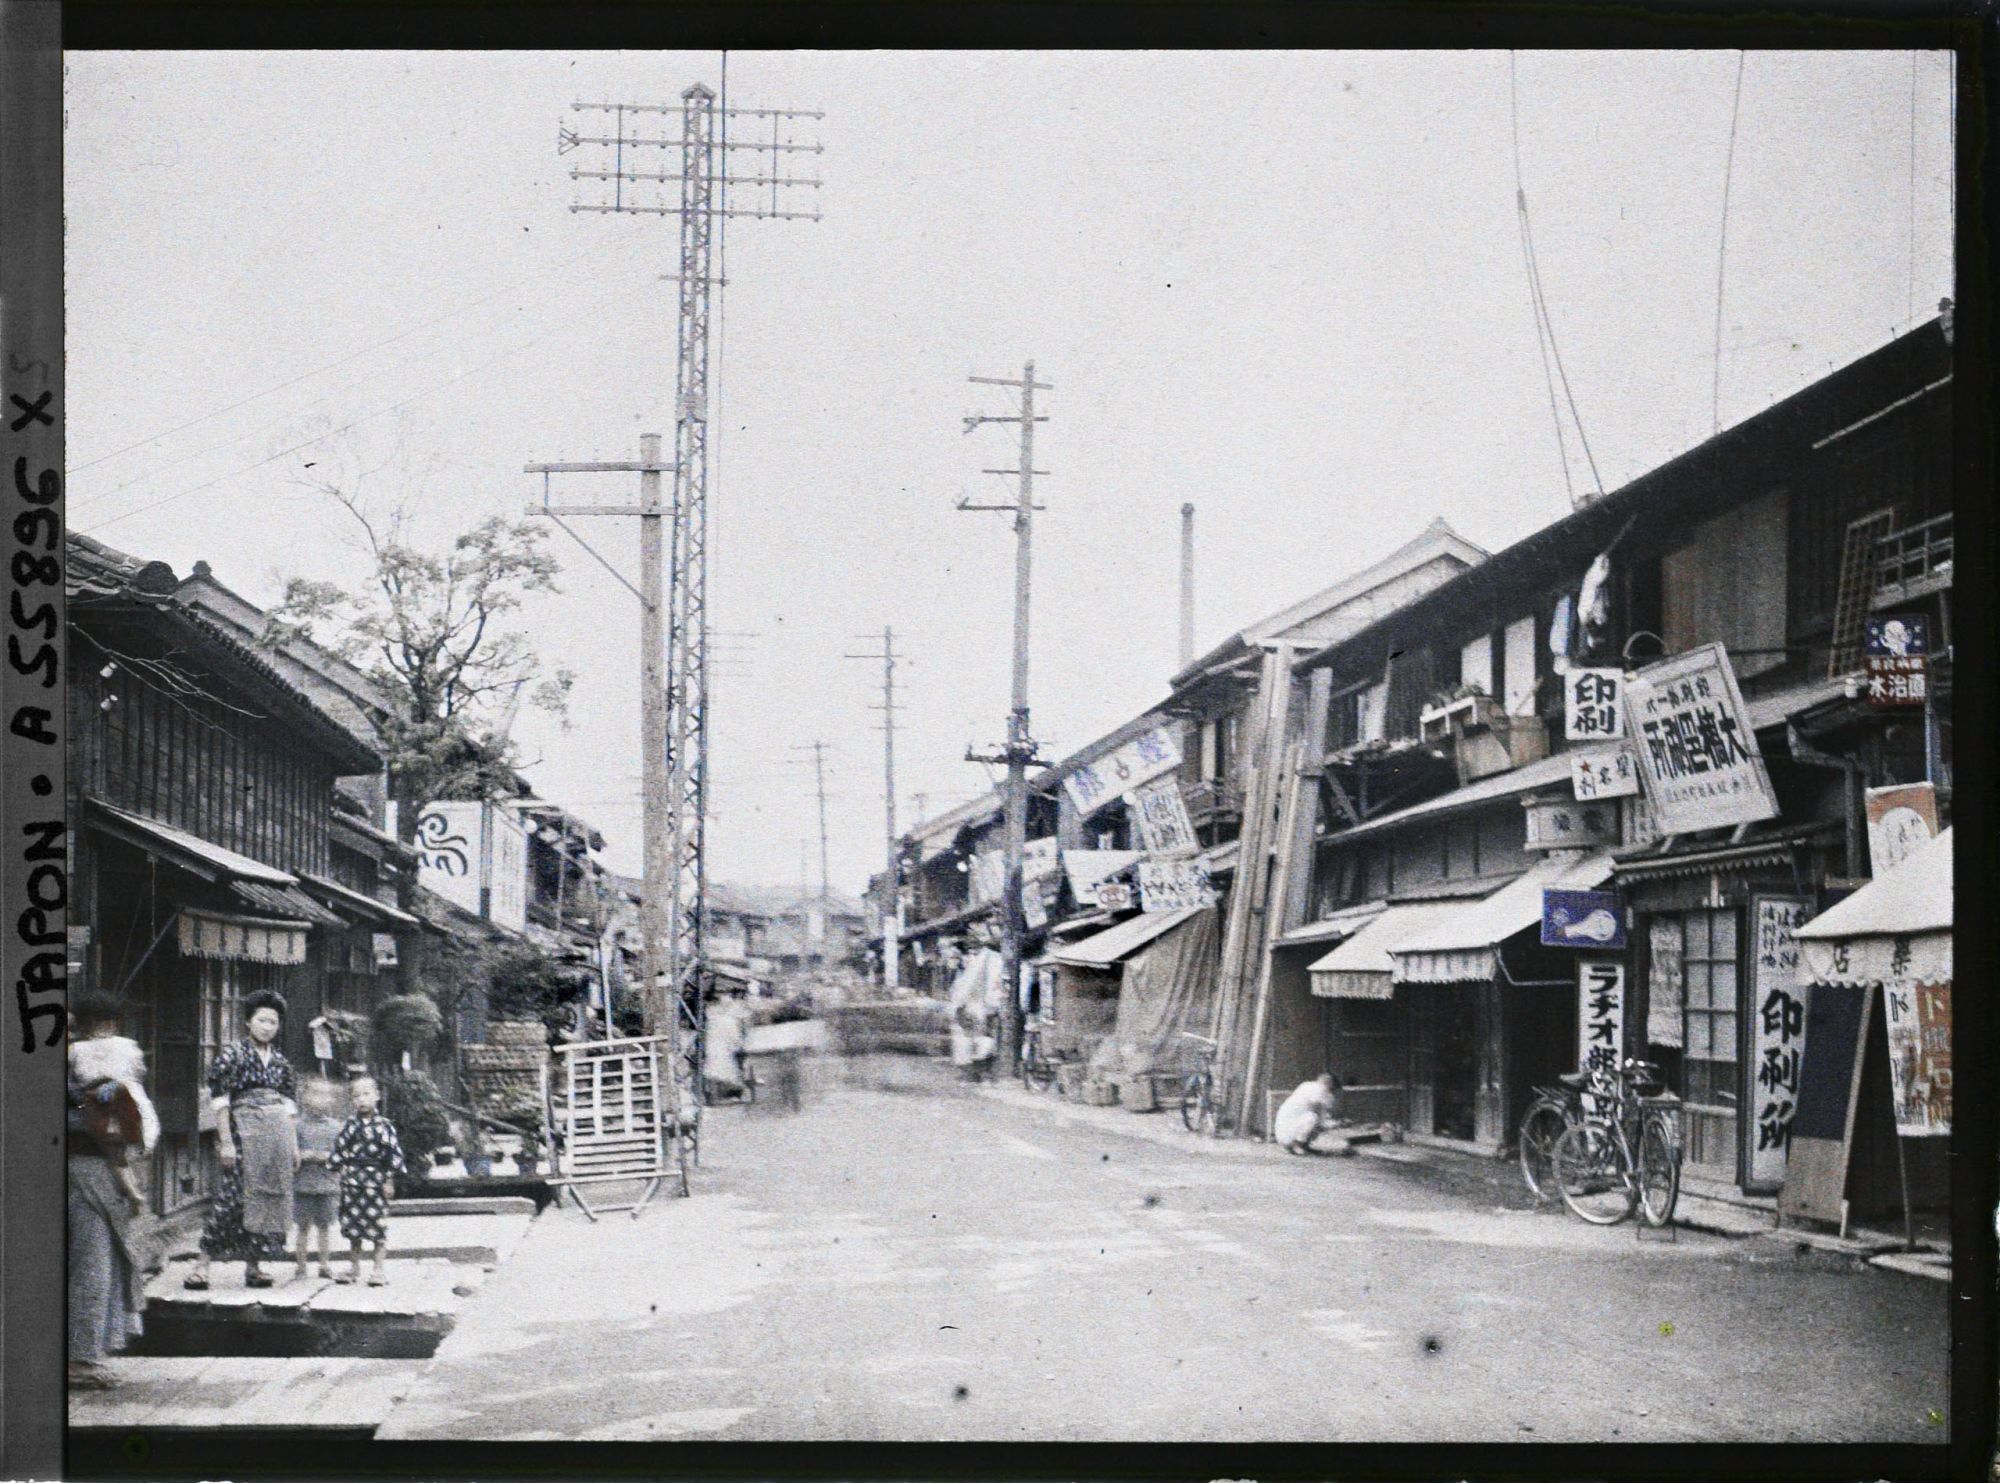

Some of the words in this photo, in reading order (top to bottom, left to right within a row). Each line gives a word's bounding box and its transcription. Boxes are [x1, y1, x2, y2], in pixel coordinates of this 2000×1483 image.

[1573, 672, 1616, 734] 印刷
[16, 820, 64, 1055] JAPON
[1759, 989, 1803, 1158] 印刷所
